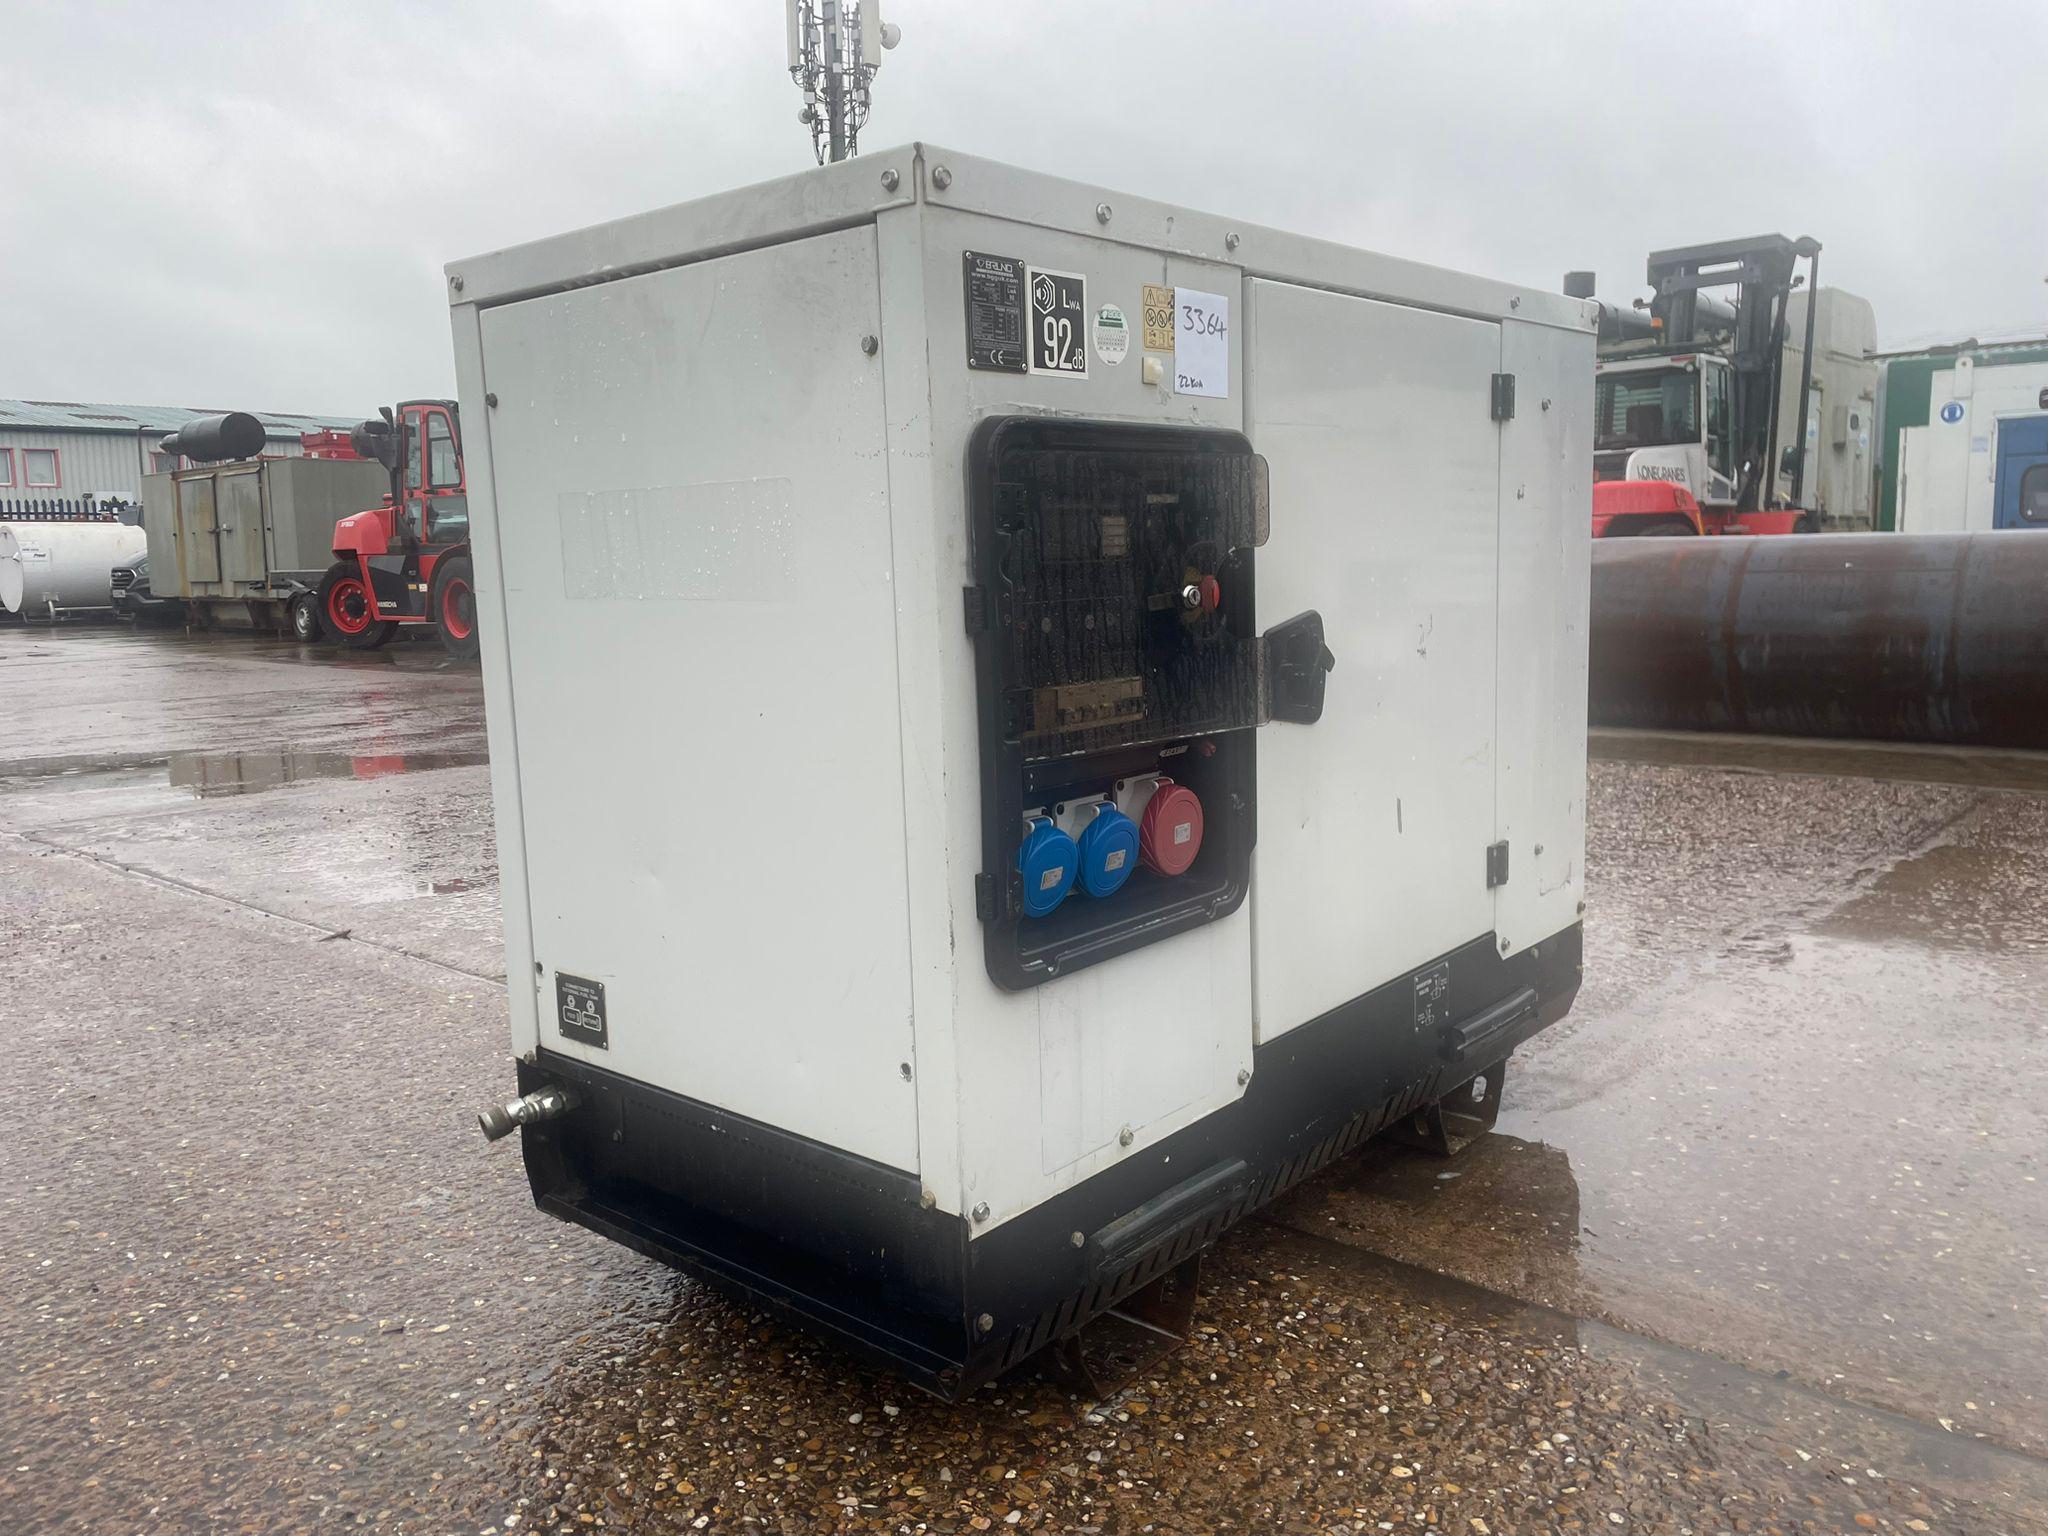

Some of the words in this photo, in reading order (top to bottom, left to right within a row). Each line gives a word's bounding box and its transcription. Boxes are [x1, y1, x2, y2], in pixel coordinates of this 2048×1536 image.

[1044, 316, 1072, 369] 92
[1072, 348, 1084, 369] dB
[1182, 305, 1227, 341] 3364
